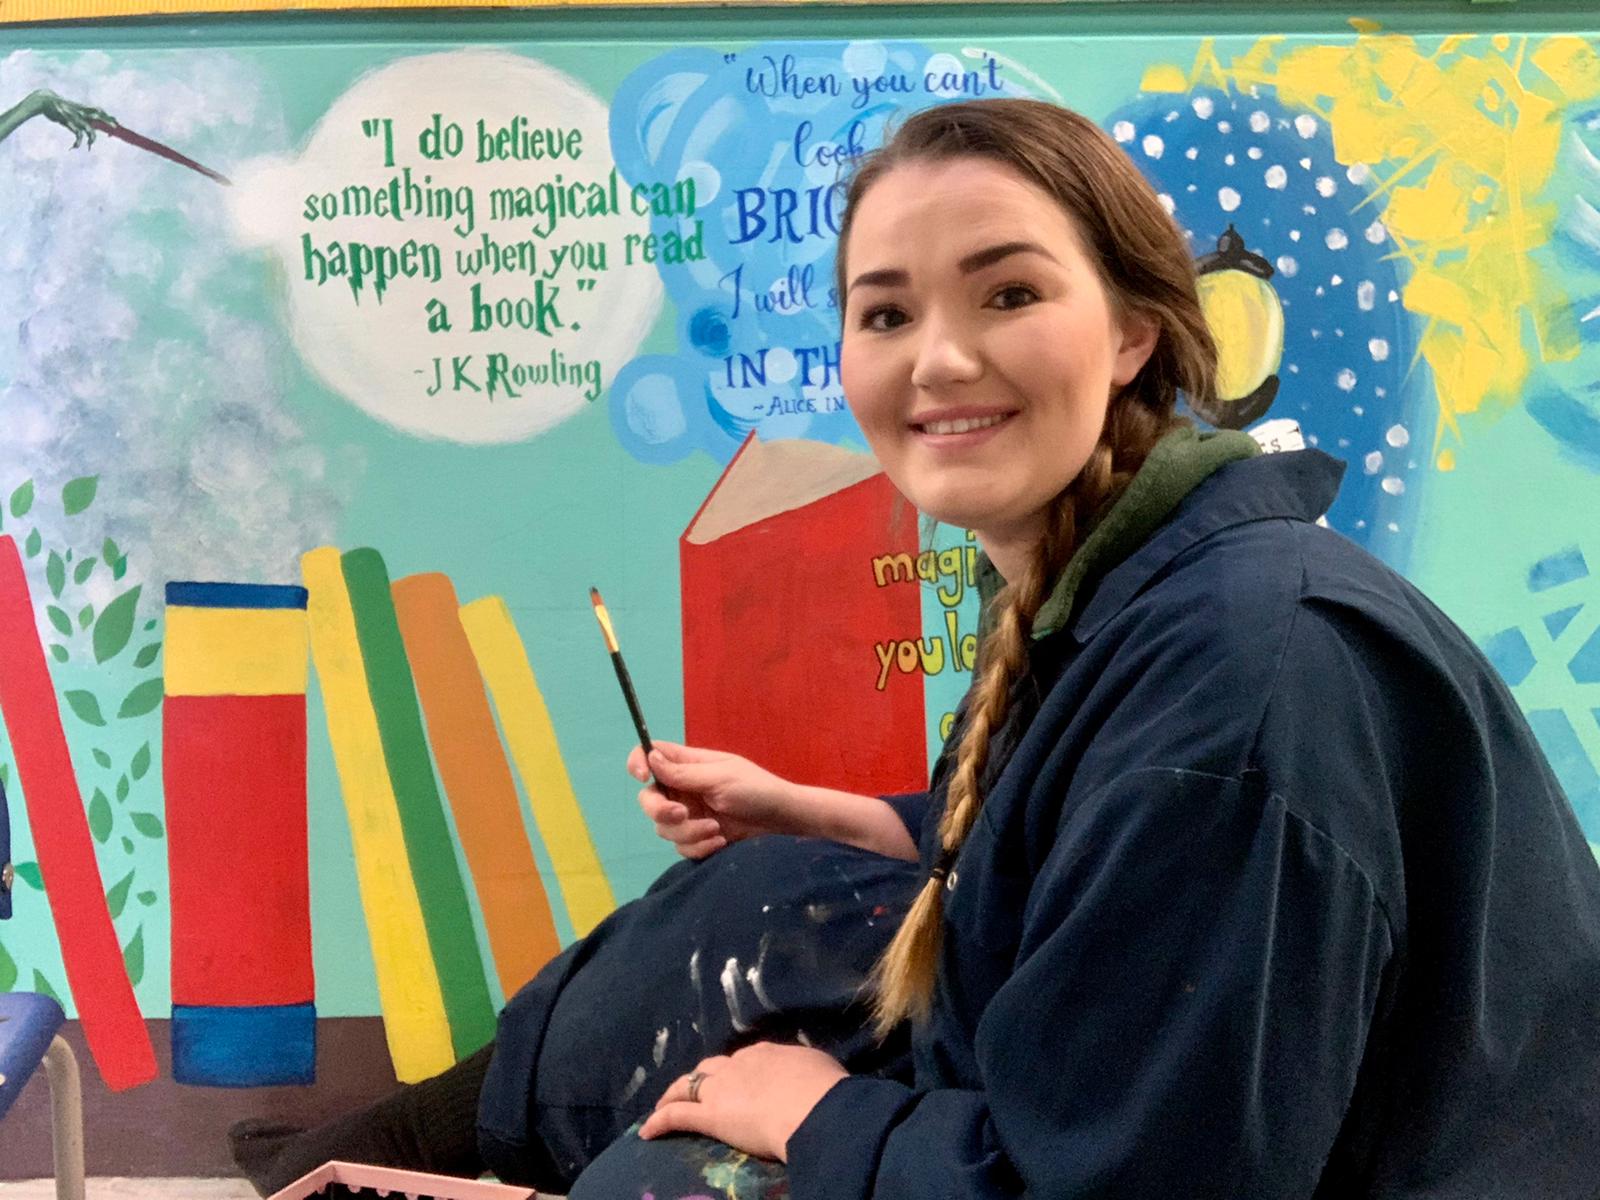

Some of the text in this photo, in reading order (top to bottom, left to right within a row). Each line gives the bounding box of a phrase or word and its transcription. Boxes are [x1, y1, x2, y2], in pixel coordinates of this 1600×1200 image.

[851, 72, 916, 110] you
[923, 52, 1004, 97] can't
[361, 113, 583, 167] "I do believe
[794, 120, 866, 169] look
[302, 167, 697, 239] something magical can
[301, 220, 706, 307] happen when you read
[754, 263, 818, 313] will
[424, 297, 453, 334] a
[486, 348, 602, 403] Rowling
[723, 348, 772, 389] IN
[825, 396, 846, 412] IN
[875, 635, 945, 692] you
